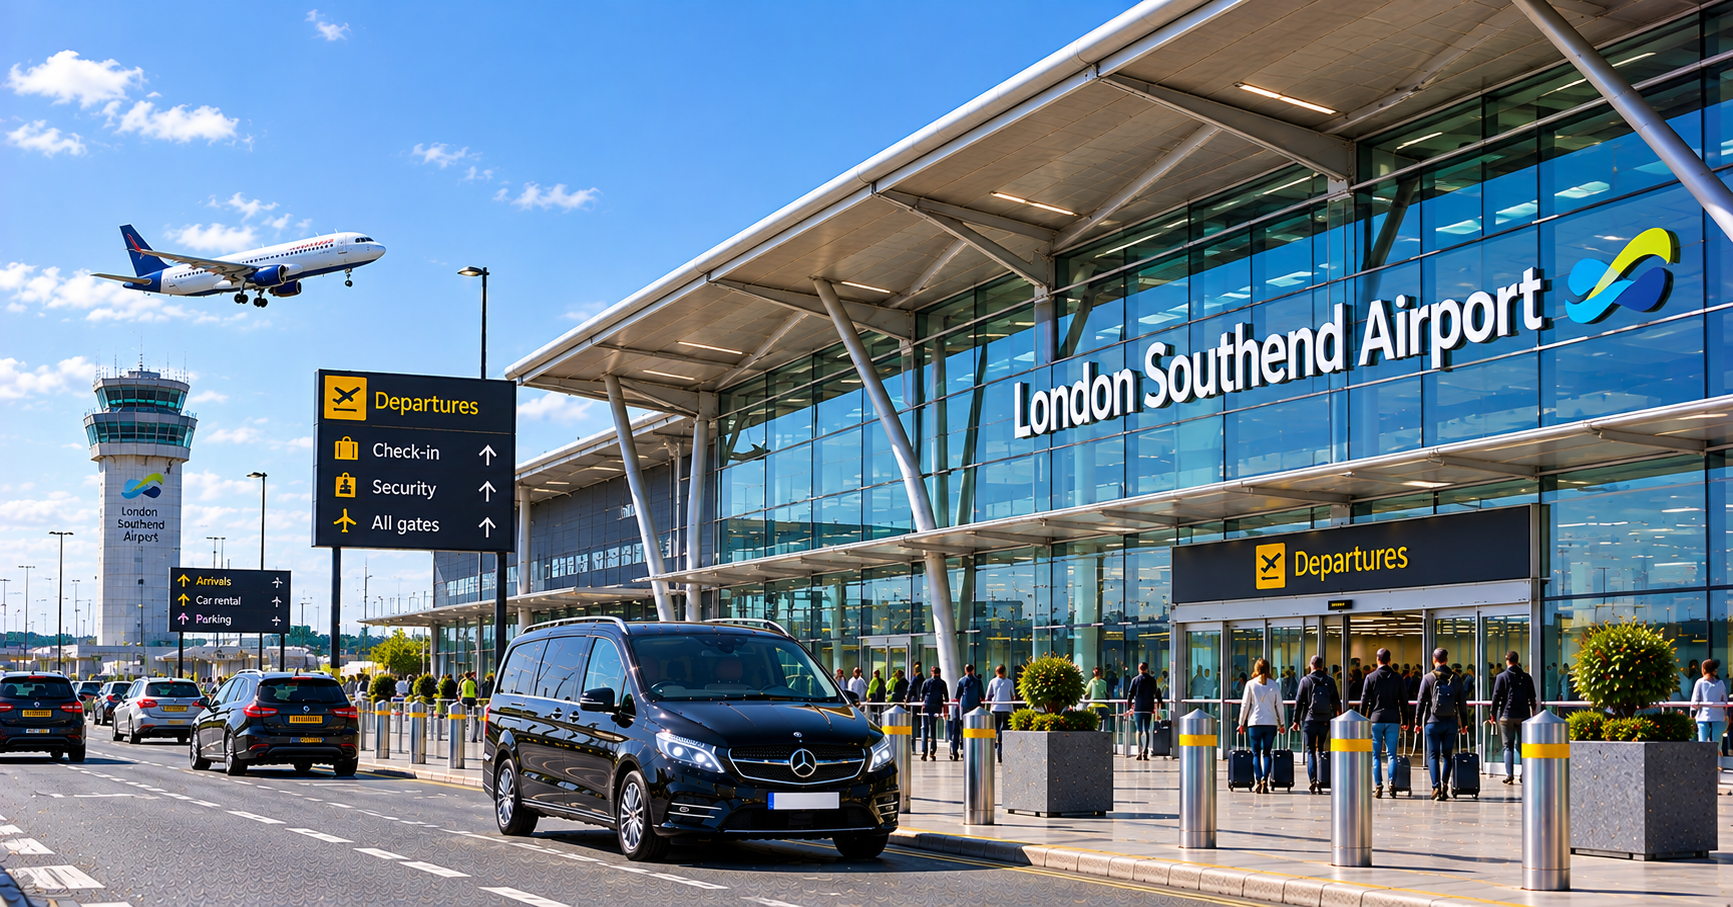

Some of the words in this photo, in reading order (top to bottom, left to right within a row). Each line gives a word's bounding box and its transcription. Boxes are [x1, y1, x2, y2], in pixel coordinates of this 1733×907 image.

[1014, 360, 1135, 439] London
[1143, 303, 1346, 409] Southend
[1358, 267, 1544, 370] Airport
[375, 391, 479, 416] Departures
[372, 442, 440, 461] Check-in
[372, 479, 437, 500] Security
[121, 506, 158, 517] London
[117, 518, 165, 530] Southend
[371, 514, 392, 530] All
[397, 517, 440, 535] gates
[1294, 545, 1409, 582] Departures
[195, 575, 232, 587] Arrivals
[195, 595, 213, 606] Car
[214, 595, 241, 606] rental
[195, 614, 232, 626] Parking
